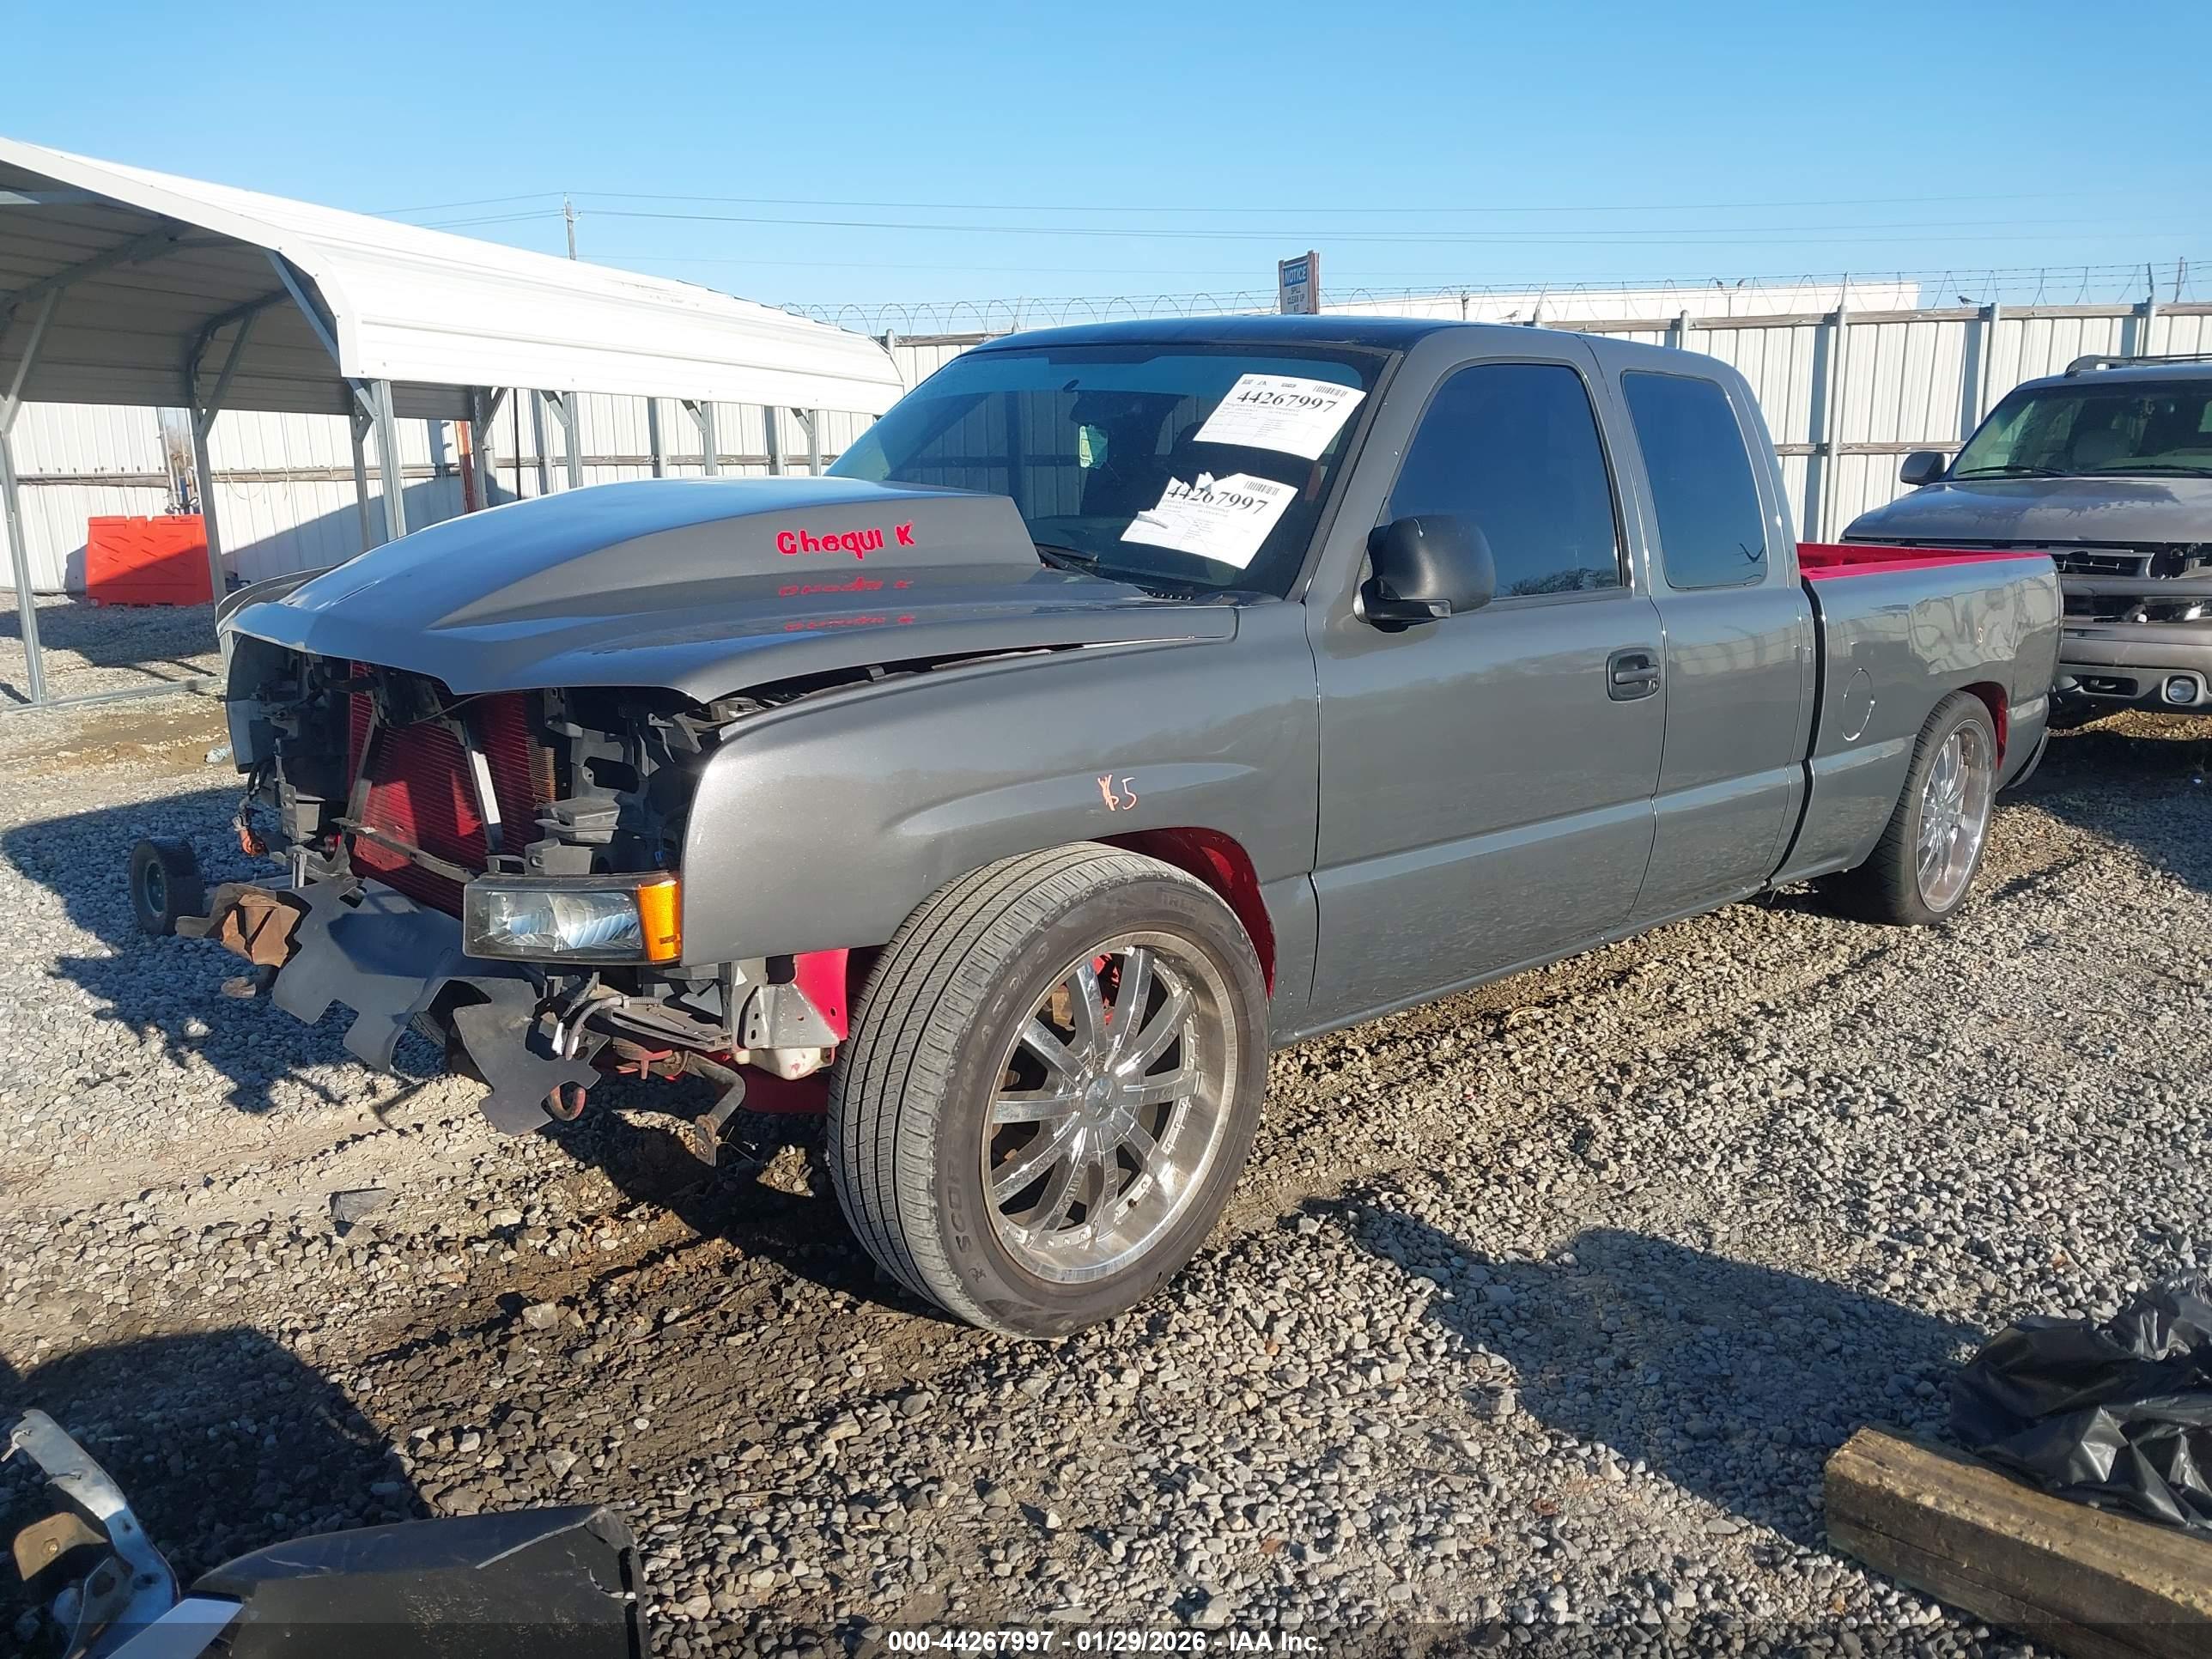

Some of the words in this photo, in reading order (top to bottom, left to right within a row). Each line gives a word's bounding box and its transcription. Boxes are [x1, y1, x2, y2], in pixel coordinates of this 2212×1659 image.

[1285, 266, 1306, 284] NOTICE
[1237, 391, 1339, 412] 44267997
[1167, 484, 1268, 515] 44267997
[896, 522, 915, 546] K
